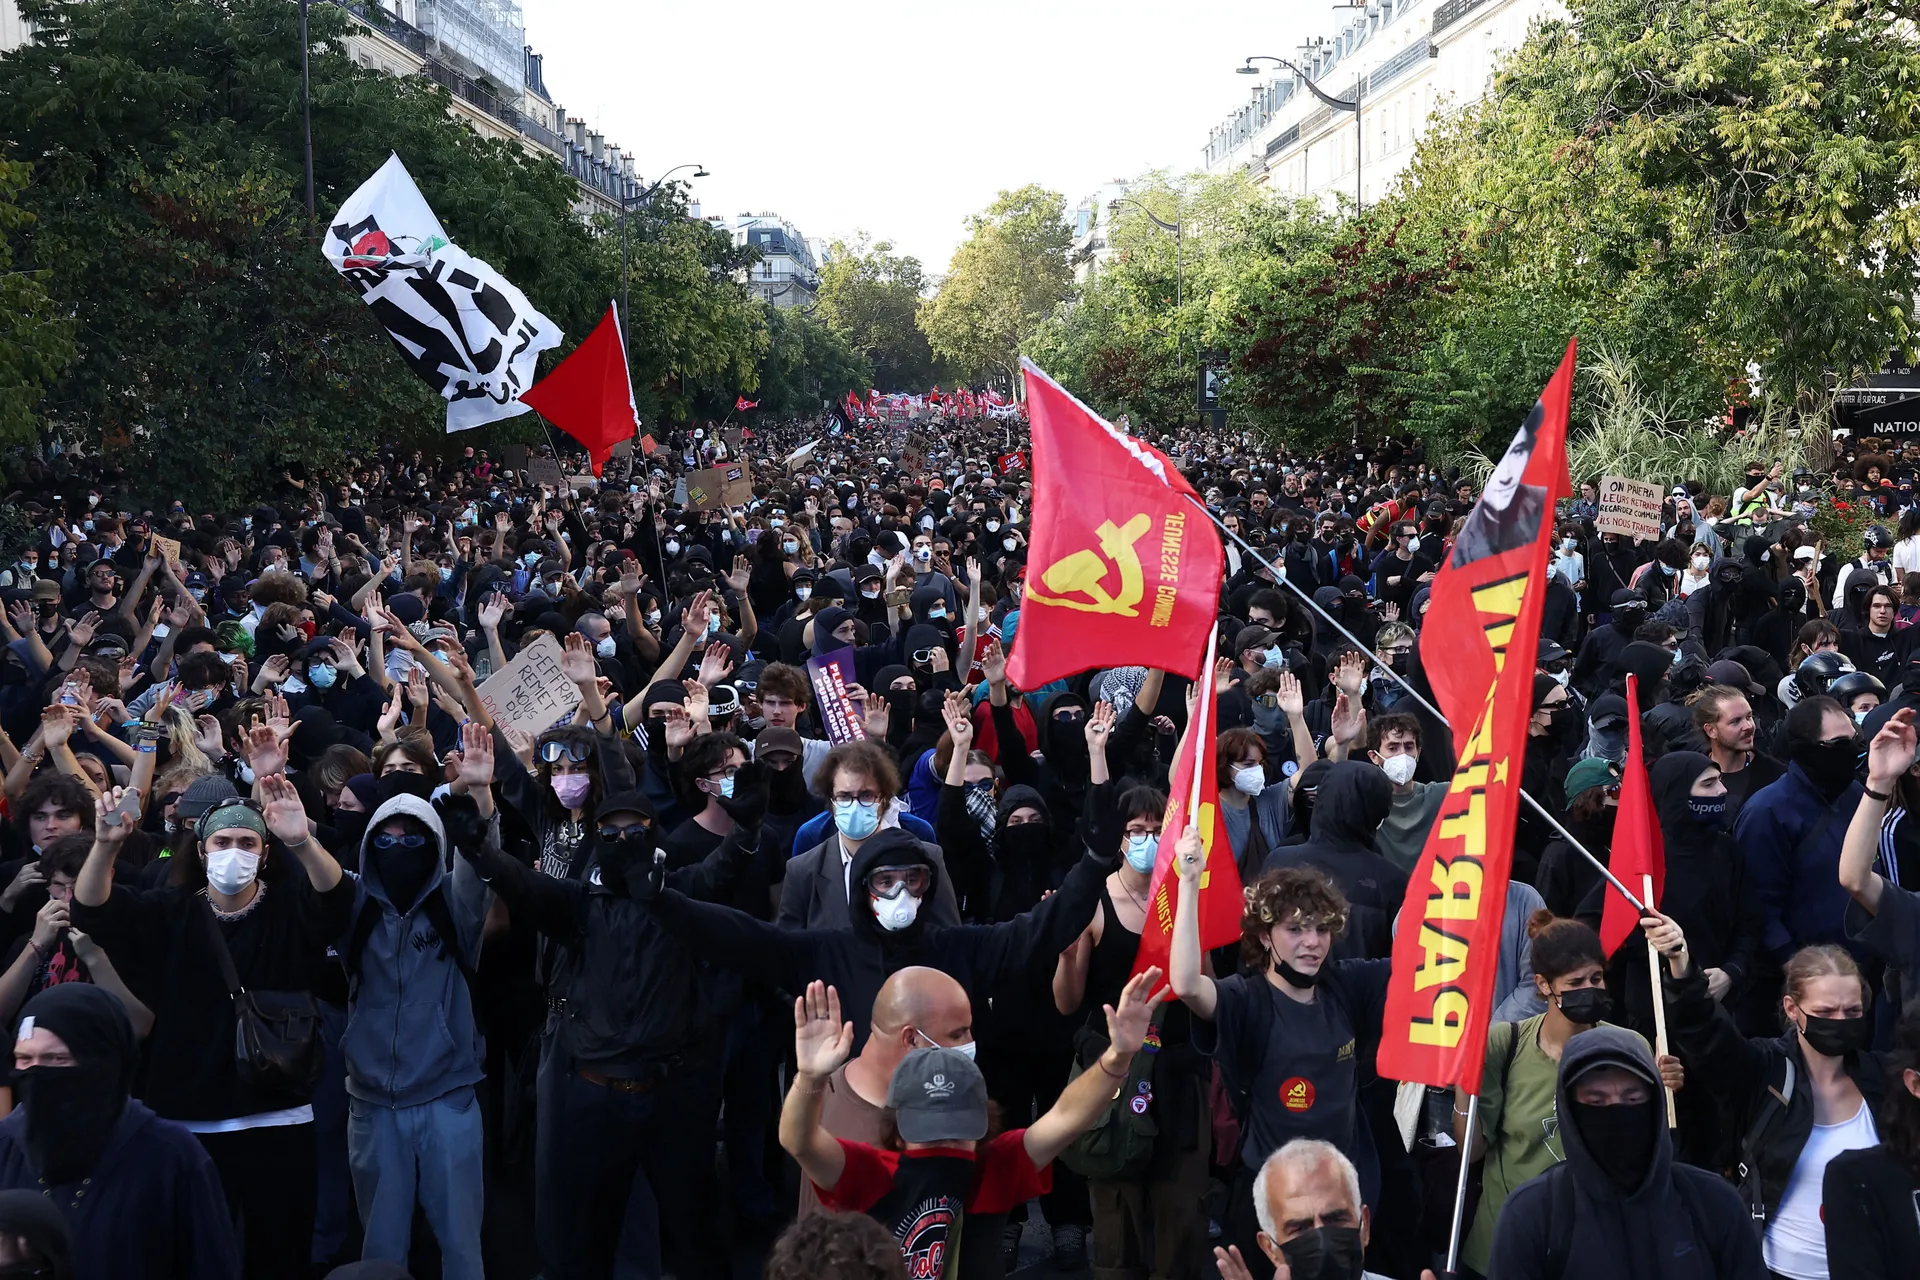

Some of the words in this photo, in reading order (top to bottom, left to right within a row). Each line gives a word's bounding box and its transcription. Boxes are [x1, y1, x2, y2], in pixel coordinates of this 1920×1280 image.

[1897, 367, 1911, 375] TACOS
[1872, 395, 1887, 404] PLACE
[1602, 493, 1630, 505] LEURS
[1609, 481, 1625, 493] ON
[1599, 504, 1633, 516] REGARDEZ
[1633, 510, 1661, 521] COMMENT
[1612, 517, 1631, 529] NOUS
[1631, 521, 1660, 535] TRAITENT
[517, 664, 557, 711] REMET
[527, 643, 579, 706] GEFFRAY
[818, 666, 837, 701] POUR
[511, 685, 538, 720] NOUS
[829, 663, 847, 697] PLUS
[841, 698, 853, 715] DE
[480, 695, 518, 741] POGNON
[506, 700, 522, 721] DU
[815, 678, 842, 739] PUBLIQUE
